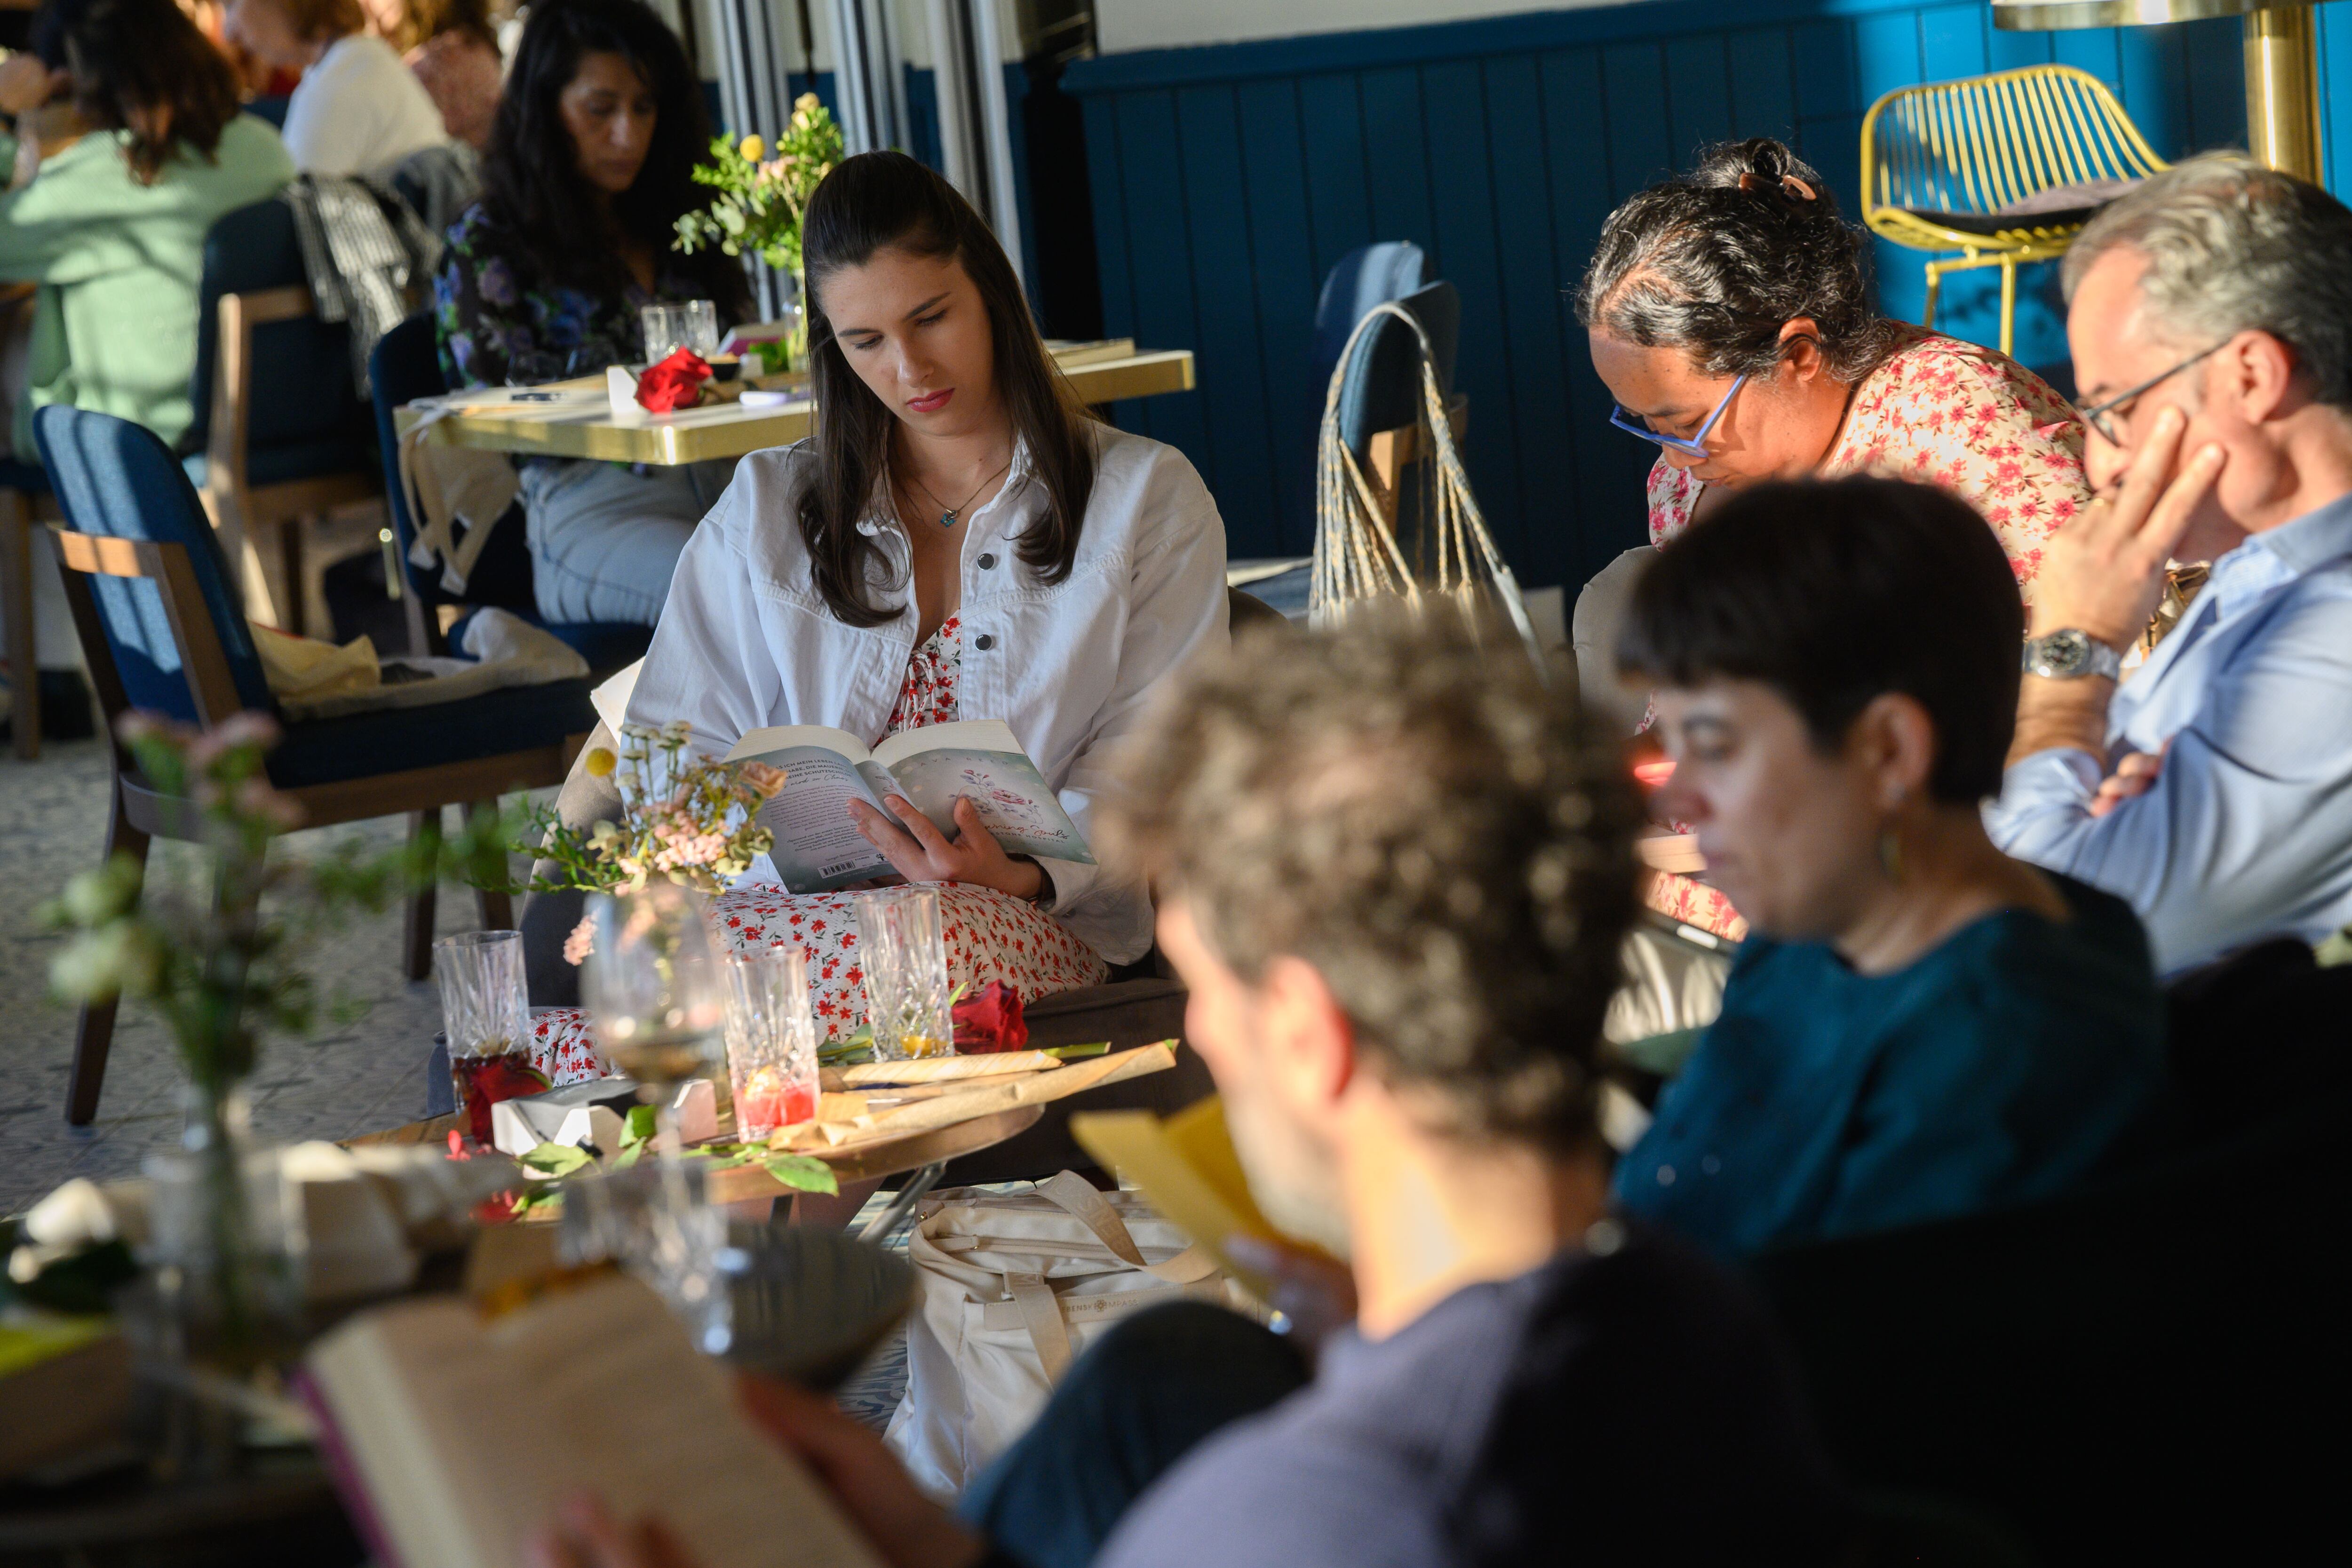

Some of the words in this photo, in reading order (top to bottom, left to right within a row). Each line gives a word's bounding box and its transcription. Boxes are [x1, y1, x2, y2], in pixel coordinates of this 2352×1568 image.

[921, 757, 951, 767] AVA
[966, 757, 1008, 765] REED
[984, 823, 1028, 834] wning
[1030, 824, 1070, 840] Souls
[1025, 835, 1065, 844] HOSPITAL
